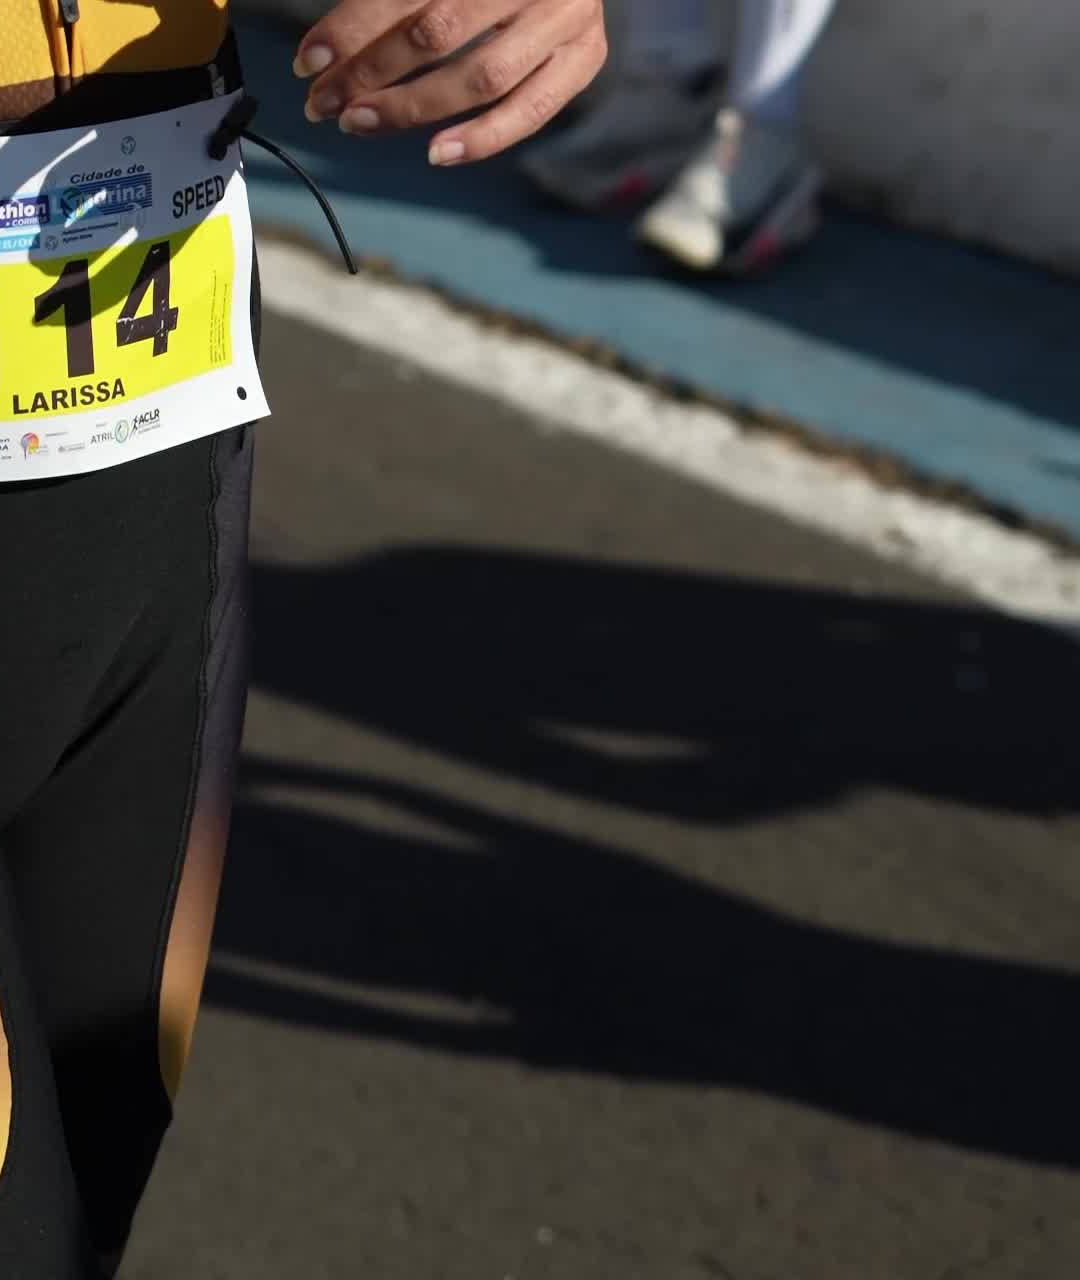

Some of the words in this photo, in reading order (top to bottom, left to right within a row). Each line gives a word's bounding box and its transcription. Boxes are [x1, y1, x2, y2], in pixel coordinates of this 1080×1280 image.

[70, 168, 122, 184] Cidade
[127, 164, 145, 175] de
[51, 183, 146, 215] Ldrina
[172, 175, 225, 219] SPEED
[13, 378, 125, 415] LARISSA
